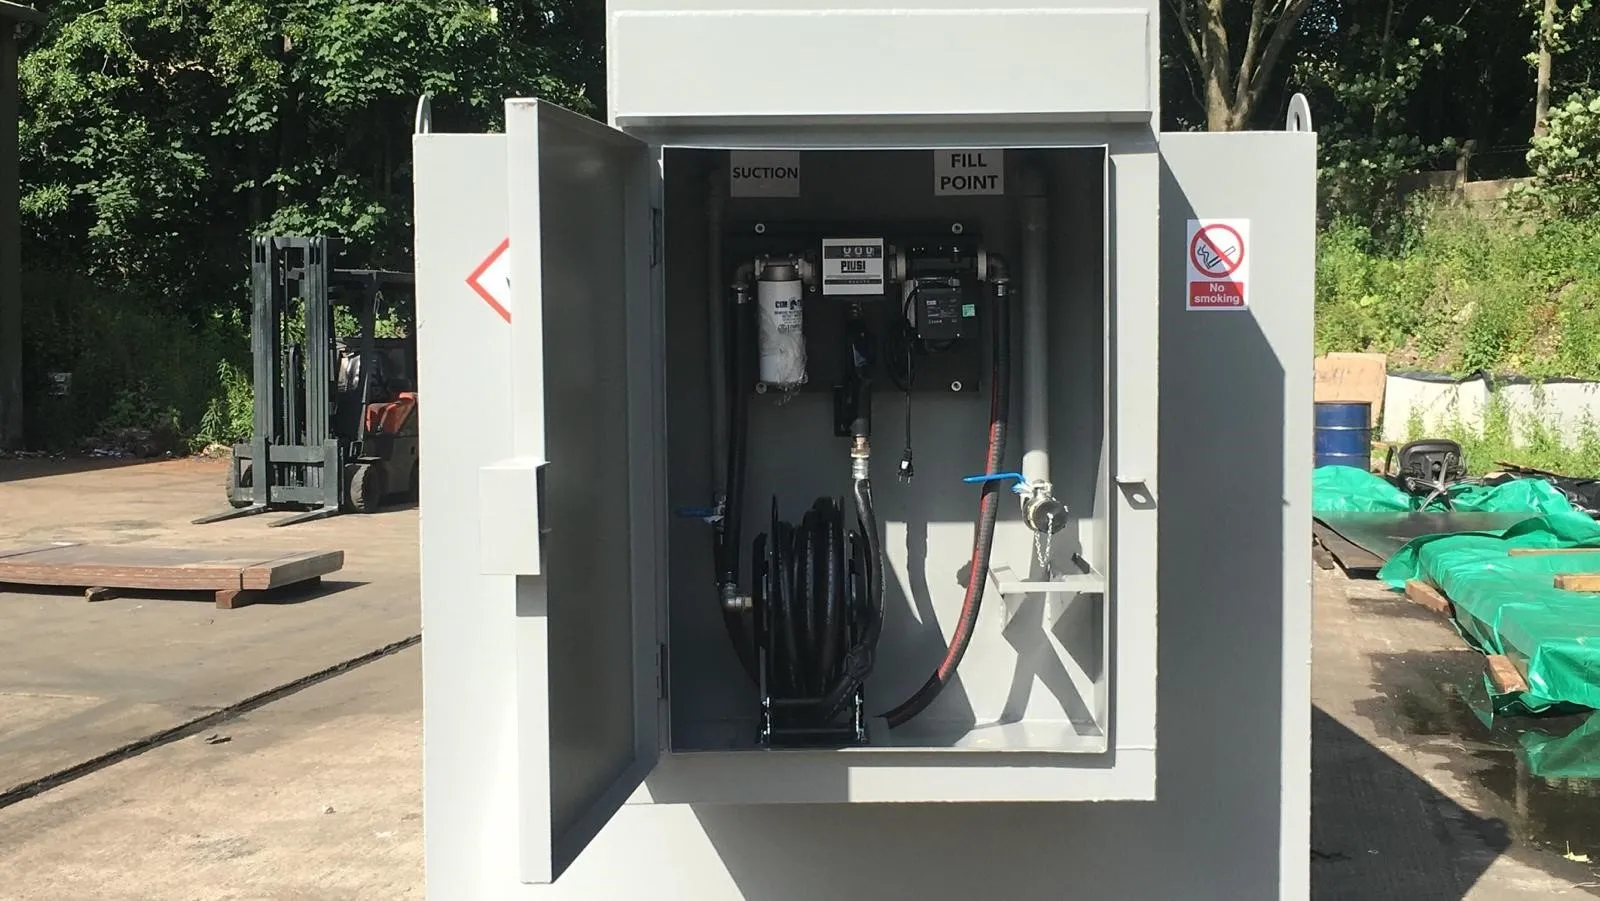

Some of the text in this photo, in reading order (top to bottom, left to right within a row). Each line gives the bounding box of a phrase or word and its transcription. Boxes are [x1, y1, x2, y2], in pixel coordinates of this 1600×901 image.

[951, 153, 987, 168] FILL
[732, 166, 798, 179] SUCTION
[940, 175, 998, 190] POINT
[841, 260, 866, 271] PIUSI
[1209, 283, 1225, 292] No
[1194, 294, 1239, 305] smoking
